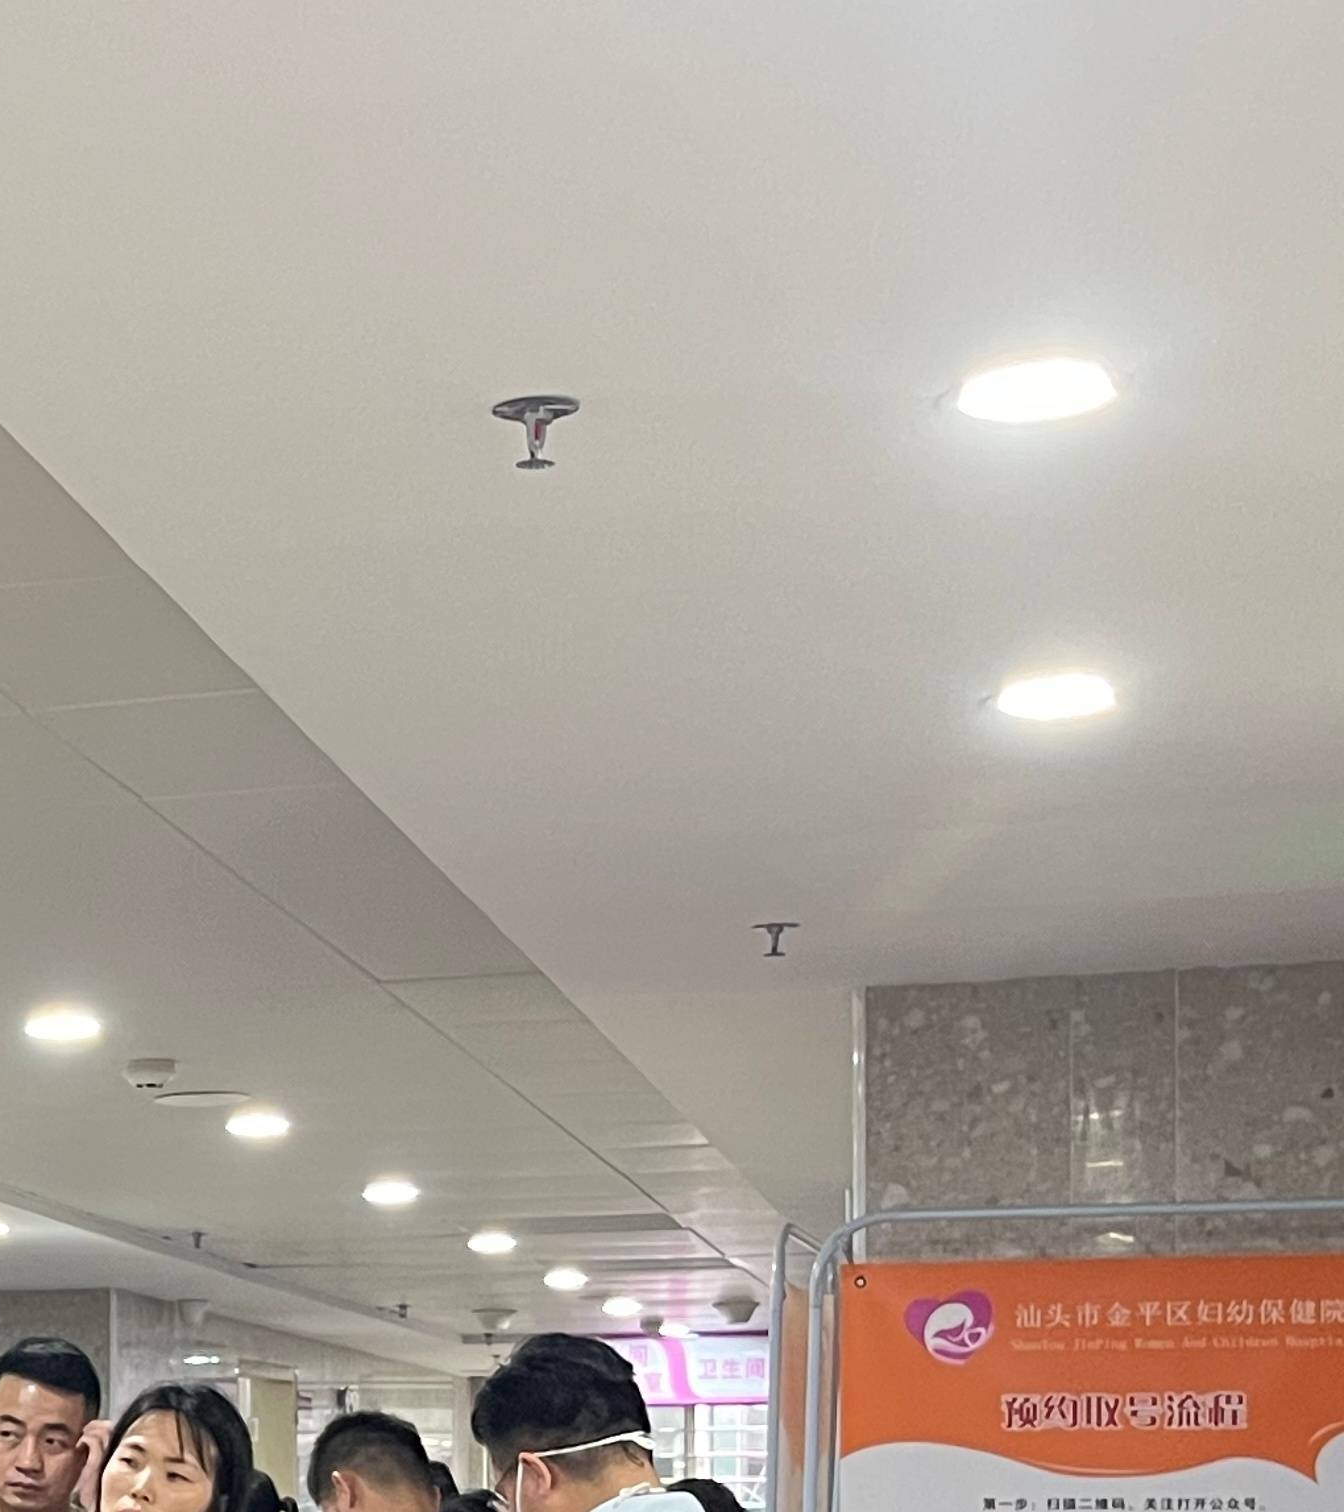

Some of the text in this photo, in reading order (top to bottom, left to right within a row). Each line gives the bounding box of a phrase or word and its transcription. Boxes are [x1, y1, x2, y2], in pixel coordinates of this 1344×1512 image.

[1016, 1299, 1344, 1329] 汕头市金平区妇幼保健院
[699, 1357, 765, 1379] 卫生间
[1006, 1393, 1246, 1428] 预约取号流程
